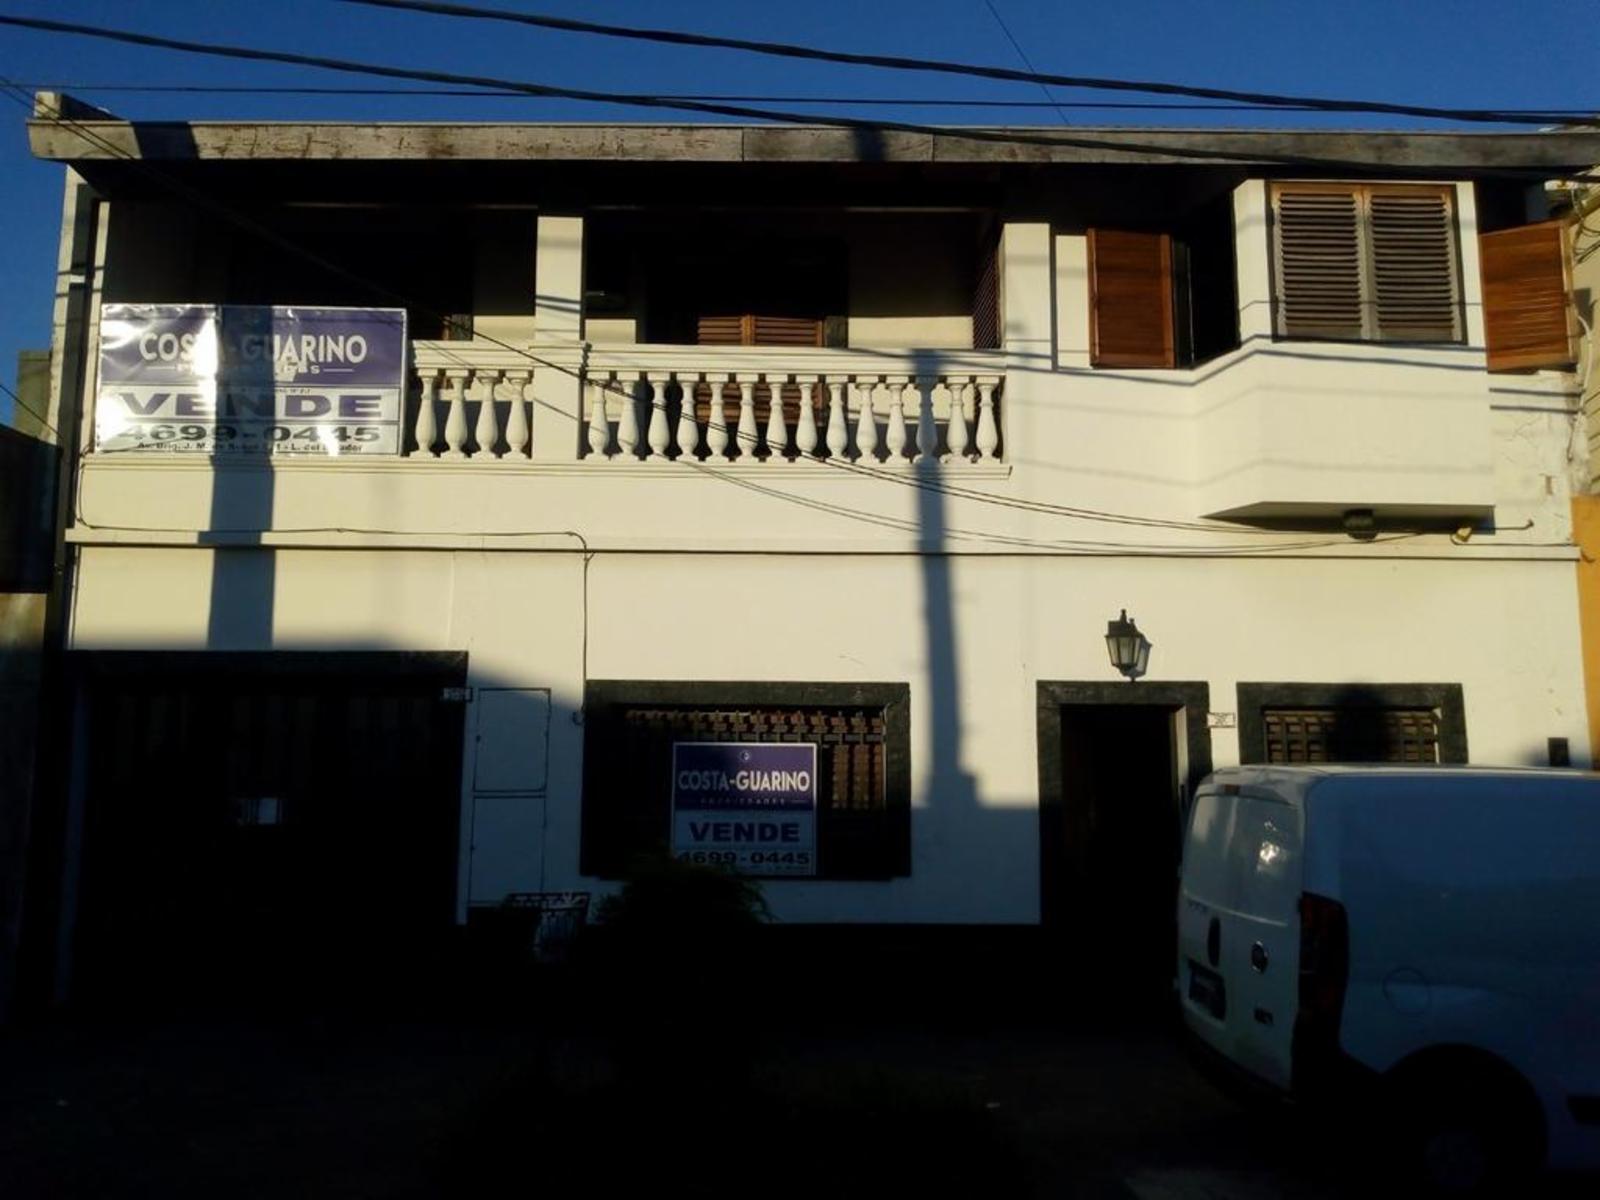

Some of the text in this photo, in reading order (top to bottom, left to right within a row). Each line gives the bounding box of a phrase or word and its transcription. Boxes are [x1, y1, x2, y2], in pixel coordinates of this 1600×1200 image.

[139, 332, 368, 365] COS-GUARINO
[119, 392, 383, 419] VENDE
[678, 770, 810, 793] COSTA-GUARINO
[688, 821, 801, 843] VENDE
[678, 850, 810, 865] 4699-0445
